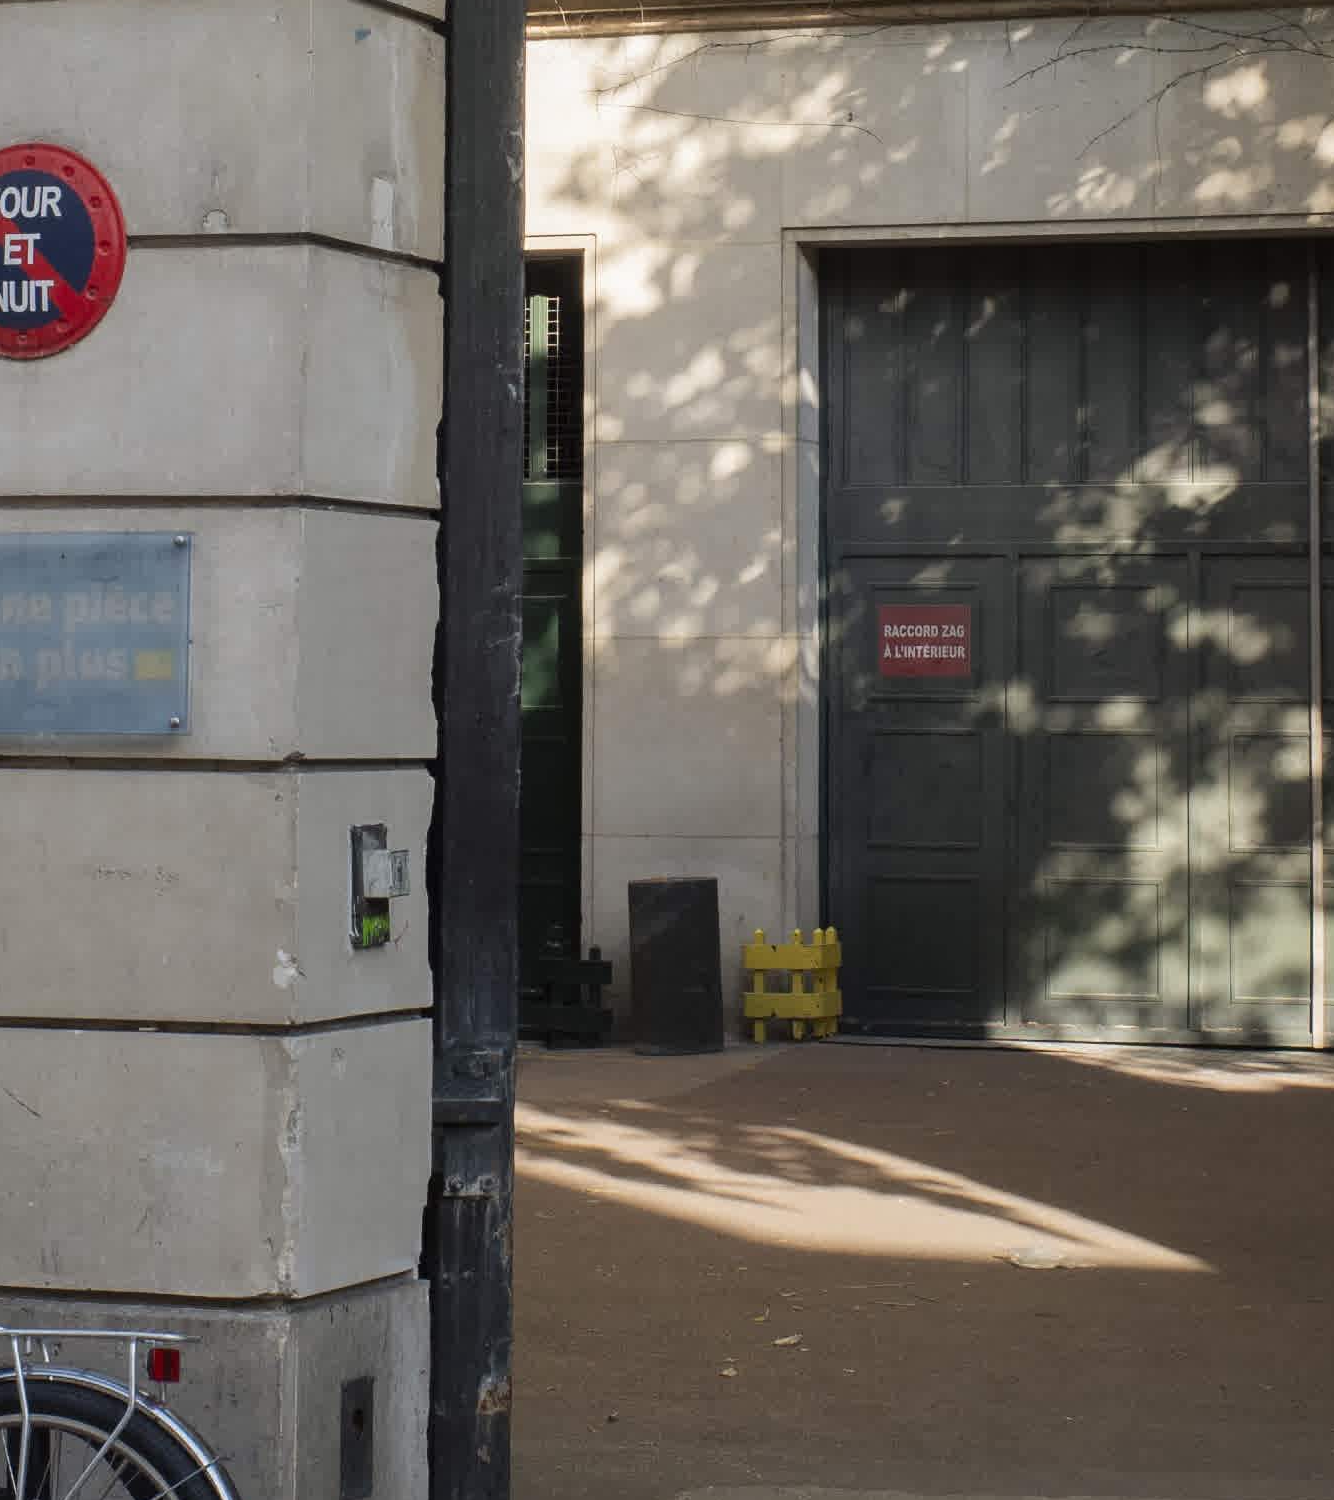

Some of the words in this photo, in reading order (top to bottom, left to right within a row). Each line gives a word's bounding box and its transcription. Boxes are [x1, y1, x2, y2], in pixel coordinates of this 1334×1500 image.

[3, 233, 41, 265] ET
[884, 624, 938, 637] RACCORD
[941, 624, 965, 637] ZAG
[883, 642, 892, 658] À
[894, 643, 966, 658] L'INTÉRIEUR
[34, 640, 126, 690] plus
